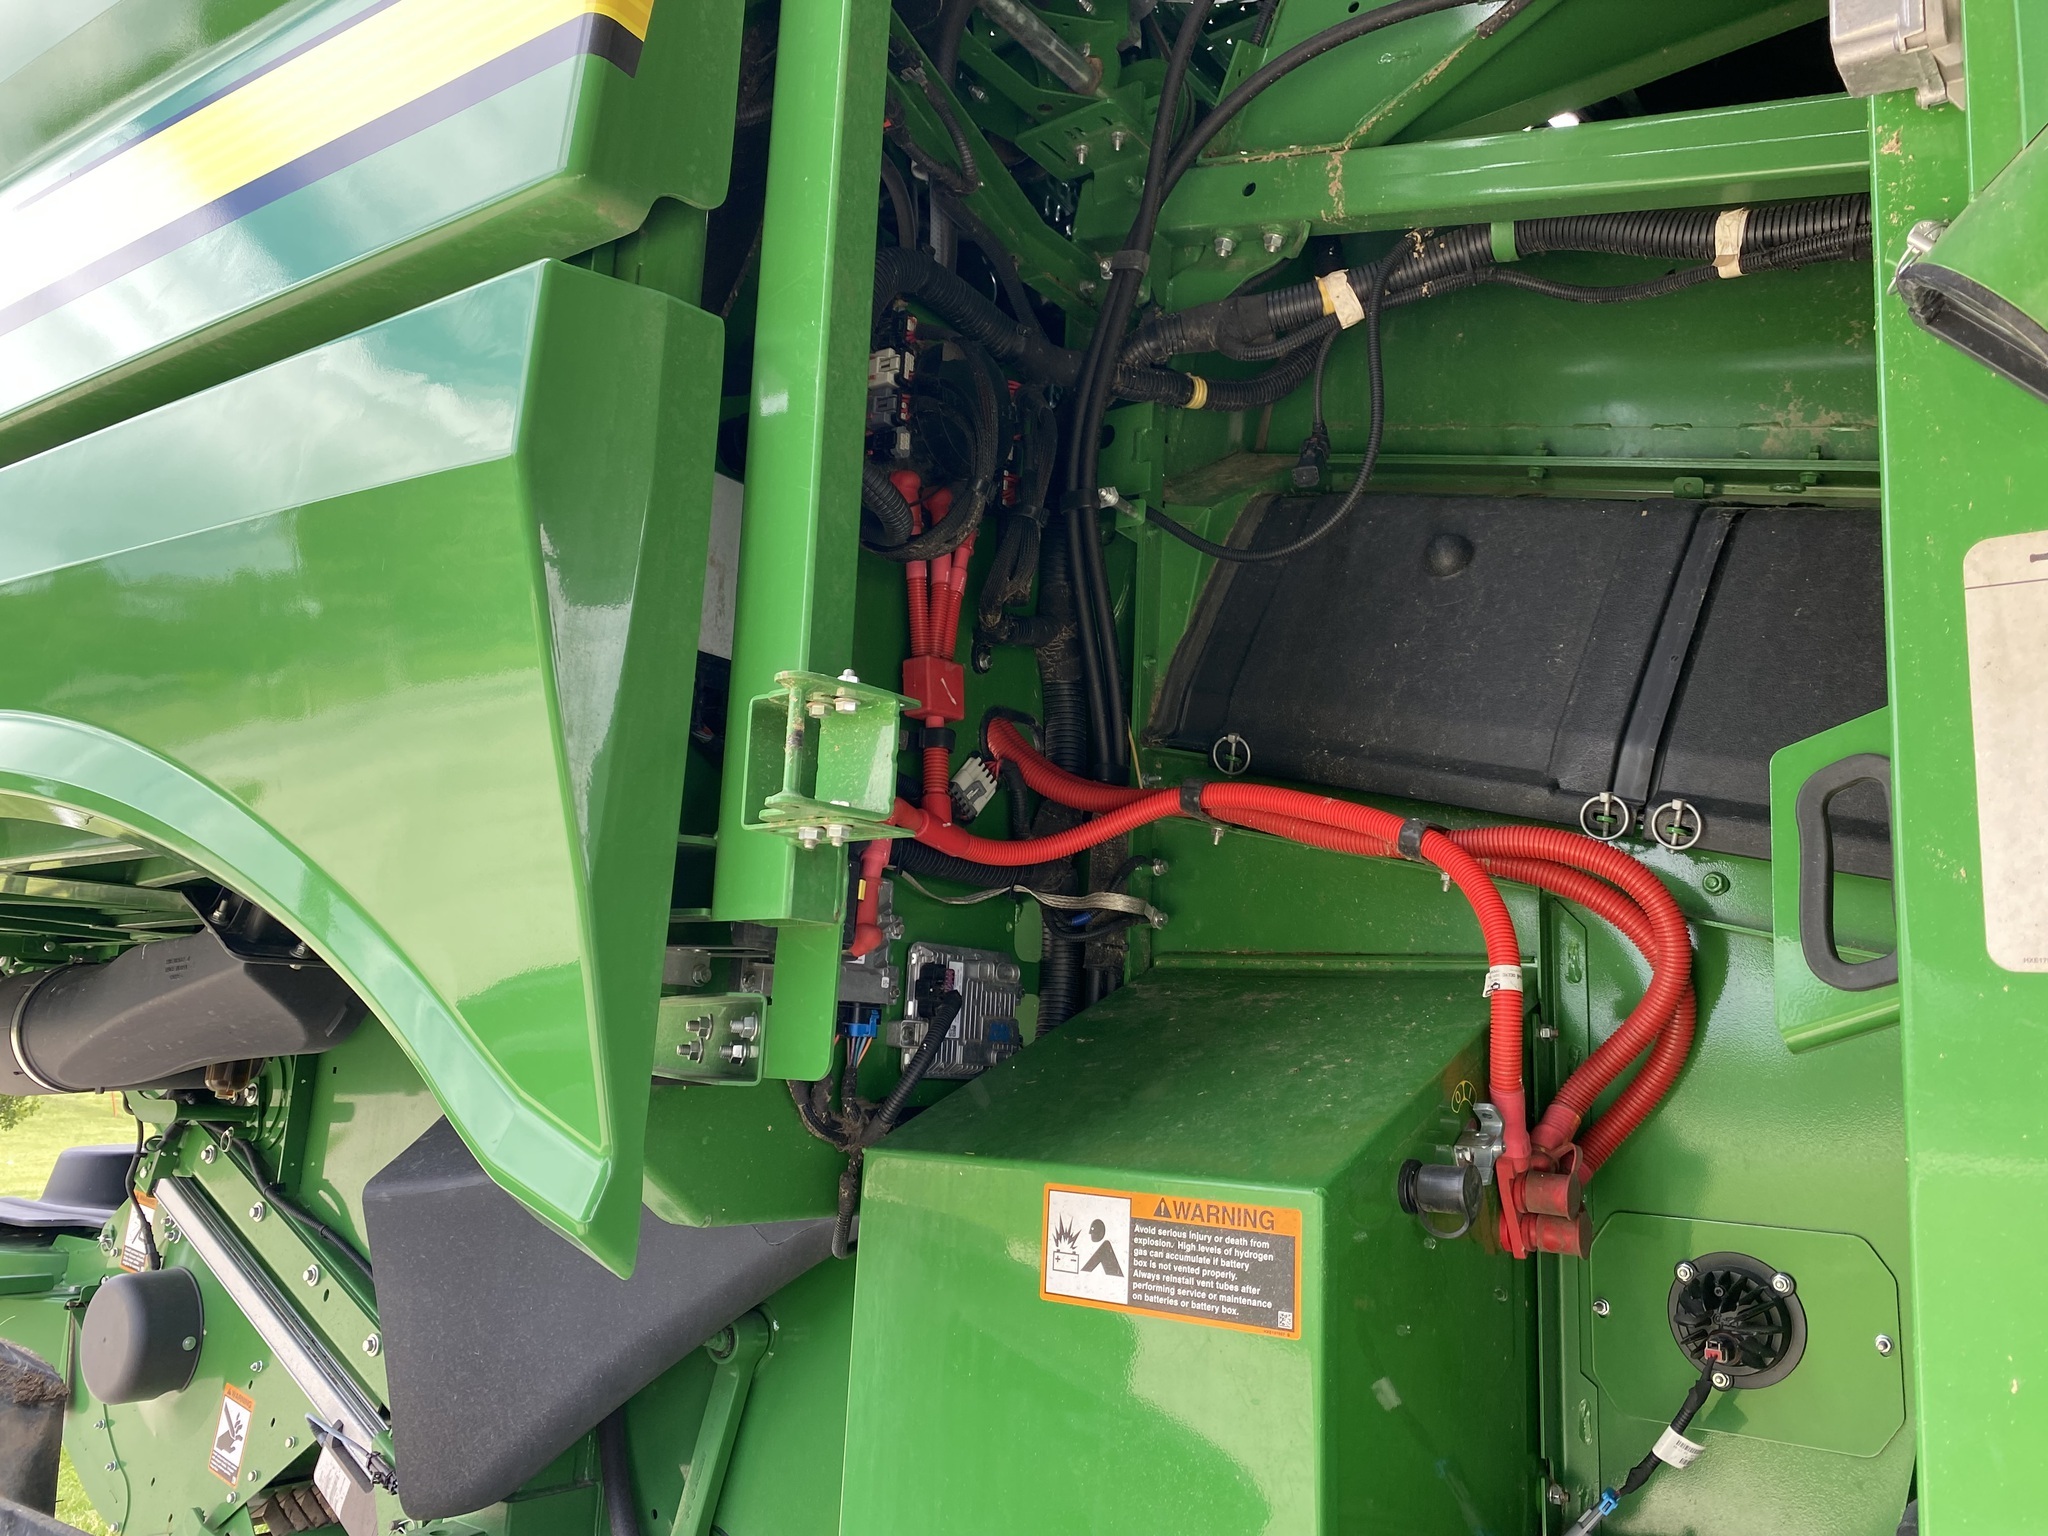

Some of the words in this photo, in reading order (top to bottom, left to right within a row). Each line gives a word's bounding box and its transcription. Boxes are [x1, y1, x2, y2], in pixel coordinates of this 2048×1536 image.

[1173, 1201, 1274, 1230] WARNING
[1134, 1225, 1156, 1234] Avoid
[1158, 1229, 1186, 1238] serious
[1189, 1231, 1212, 1243] injury
[1225, 1236, 1248, 1246] death
[1250, 1239, 1269, 1249] from
[1134, 1237, 1174, 1248] explosion.
[1178, 1241, 1196, 1252] High
[1198, 1243, 1221, 1254] levels
[1235, 1249, 1273, 1261] hydrogen
[1133, 1258, 1147, 1267] box
[1150, 1260, 1156, 1268] is
[1174, 1265, 1200, 1275] vented
[1202, 1269, 1237, 1281] properly.
[1166, 1254, 1210, 1264] accumulate
[1213, 1257, 1218, 1265] if
[1221, 1258, 1249, 1271] battery
[1133, 1270, 1160, 1281] Always
[1163, 1274, 1194, 1285] reinstall
[1197, 1280, 1213, 1288] vent
[1216, 1281, 1239, 1292] tubes
[1241, 1285, 1260, 1294] after
[1133, 1282, 1175, 1296] performing
[1177, 1289, 1206, 1299] service
[1219, 1295, 1272, 1308] maintenance
[1145, 1294, 1178, 1306] batteries
[1191, 1300, 1219, 1314] battery
[1222, 1305, 1239, 1315] box.
